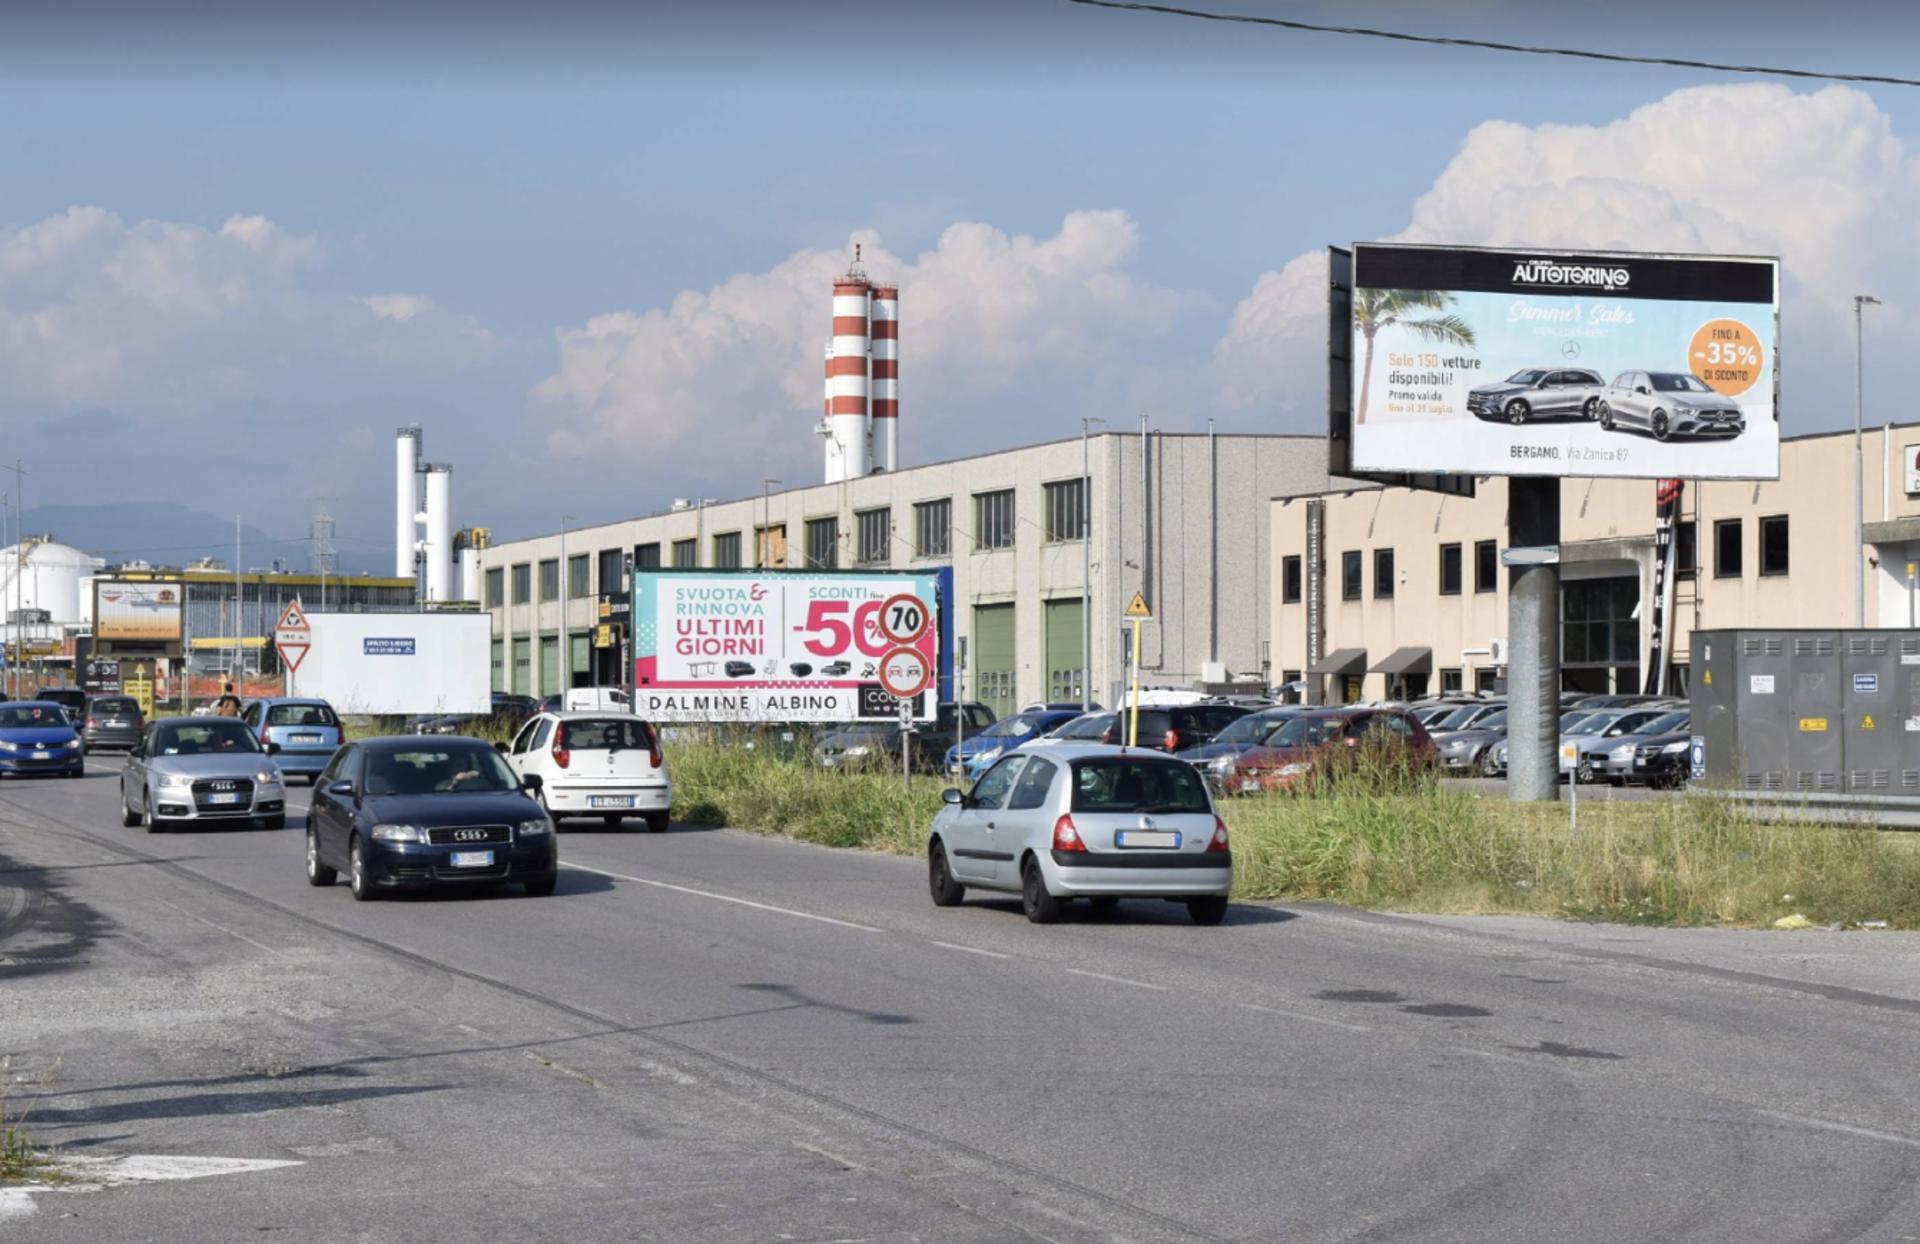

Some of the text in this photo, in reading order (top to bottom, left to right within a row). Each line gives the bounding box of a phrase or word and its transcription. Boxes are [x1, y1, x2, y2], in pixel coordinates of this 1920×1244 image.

[1512, 265, 1629, 286] AUTOTORINO
[1508, 300, 1634, 325] Summer Sales
[1712, 328, 1741, 340] FINO A
[1388, 352, 1481, 369] Solo 150 vetture
[1694, 341, 1757, 366] -35%
[1388, 370, 1453, 386] disponibili!
[1703, 369, 1749, 382] DI SCONTO
[1388, 390, 1442, 401] Promo valida
[1566, 447, 1581, 460] Via
[1583, 448, 1615, 461] Zanica
[676, 588, 747, 601] SVUOTA
[809, 586, 867, 599] SCONTI
[676, 603, 764, 615] RINNOVA
[892, 606, 920, 632] 70
[676, 619, 764, 636] ULTIMI
[675, 638, 764, 656] GIORNI
[649, 695, 838, 711] DALMINE ALBINO
